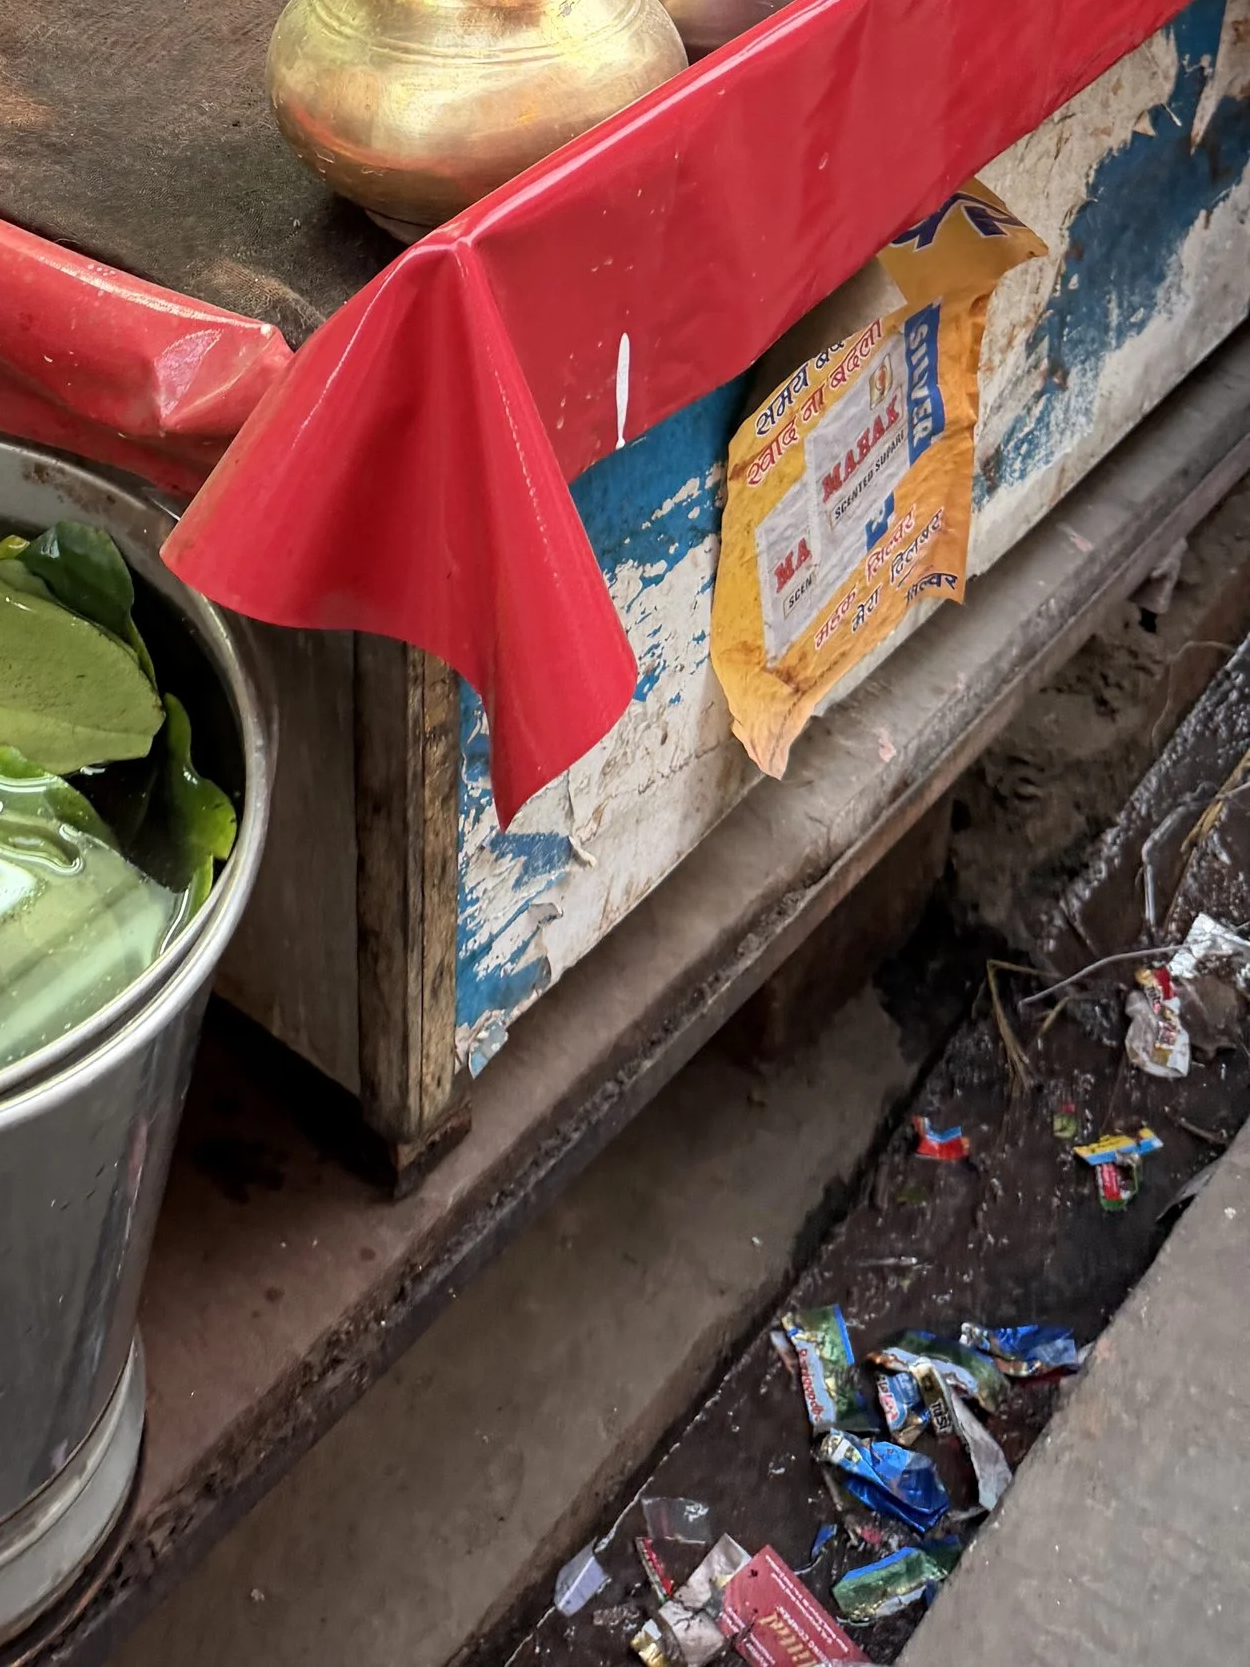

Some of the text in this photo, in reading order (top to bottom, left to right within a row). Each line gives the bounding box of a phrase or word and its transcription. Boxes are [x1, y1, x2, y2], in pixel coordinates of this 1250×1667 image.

[756, 360, 810, 437] समय
[821, 394, 901, 503] MAHAK
[834, 469, 874, 520] SCENTED
